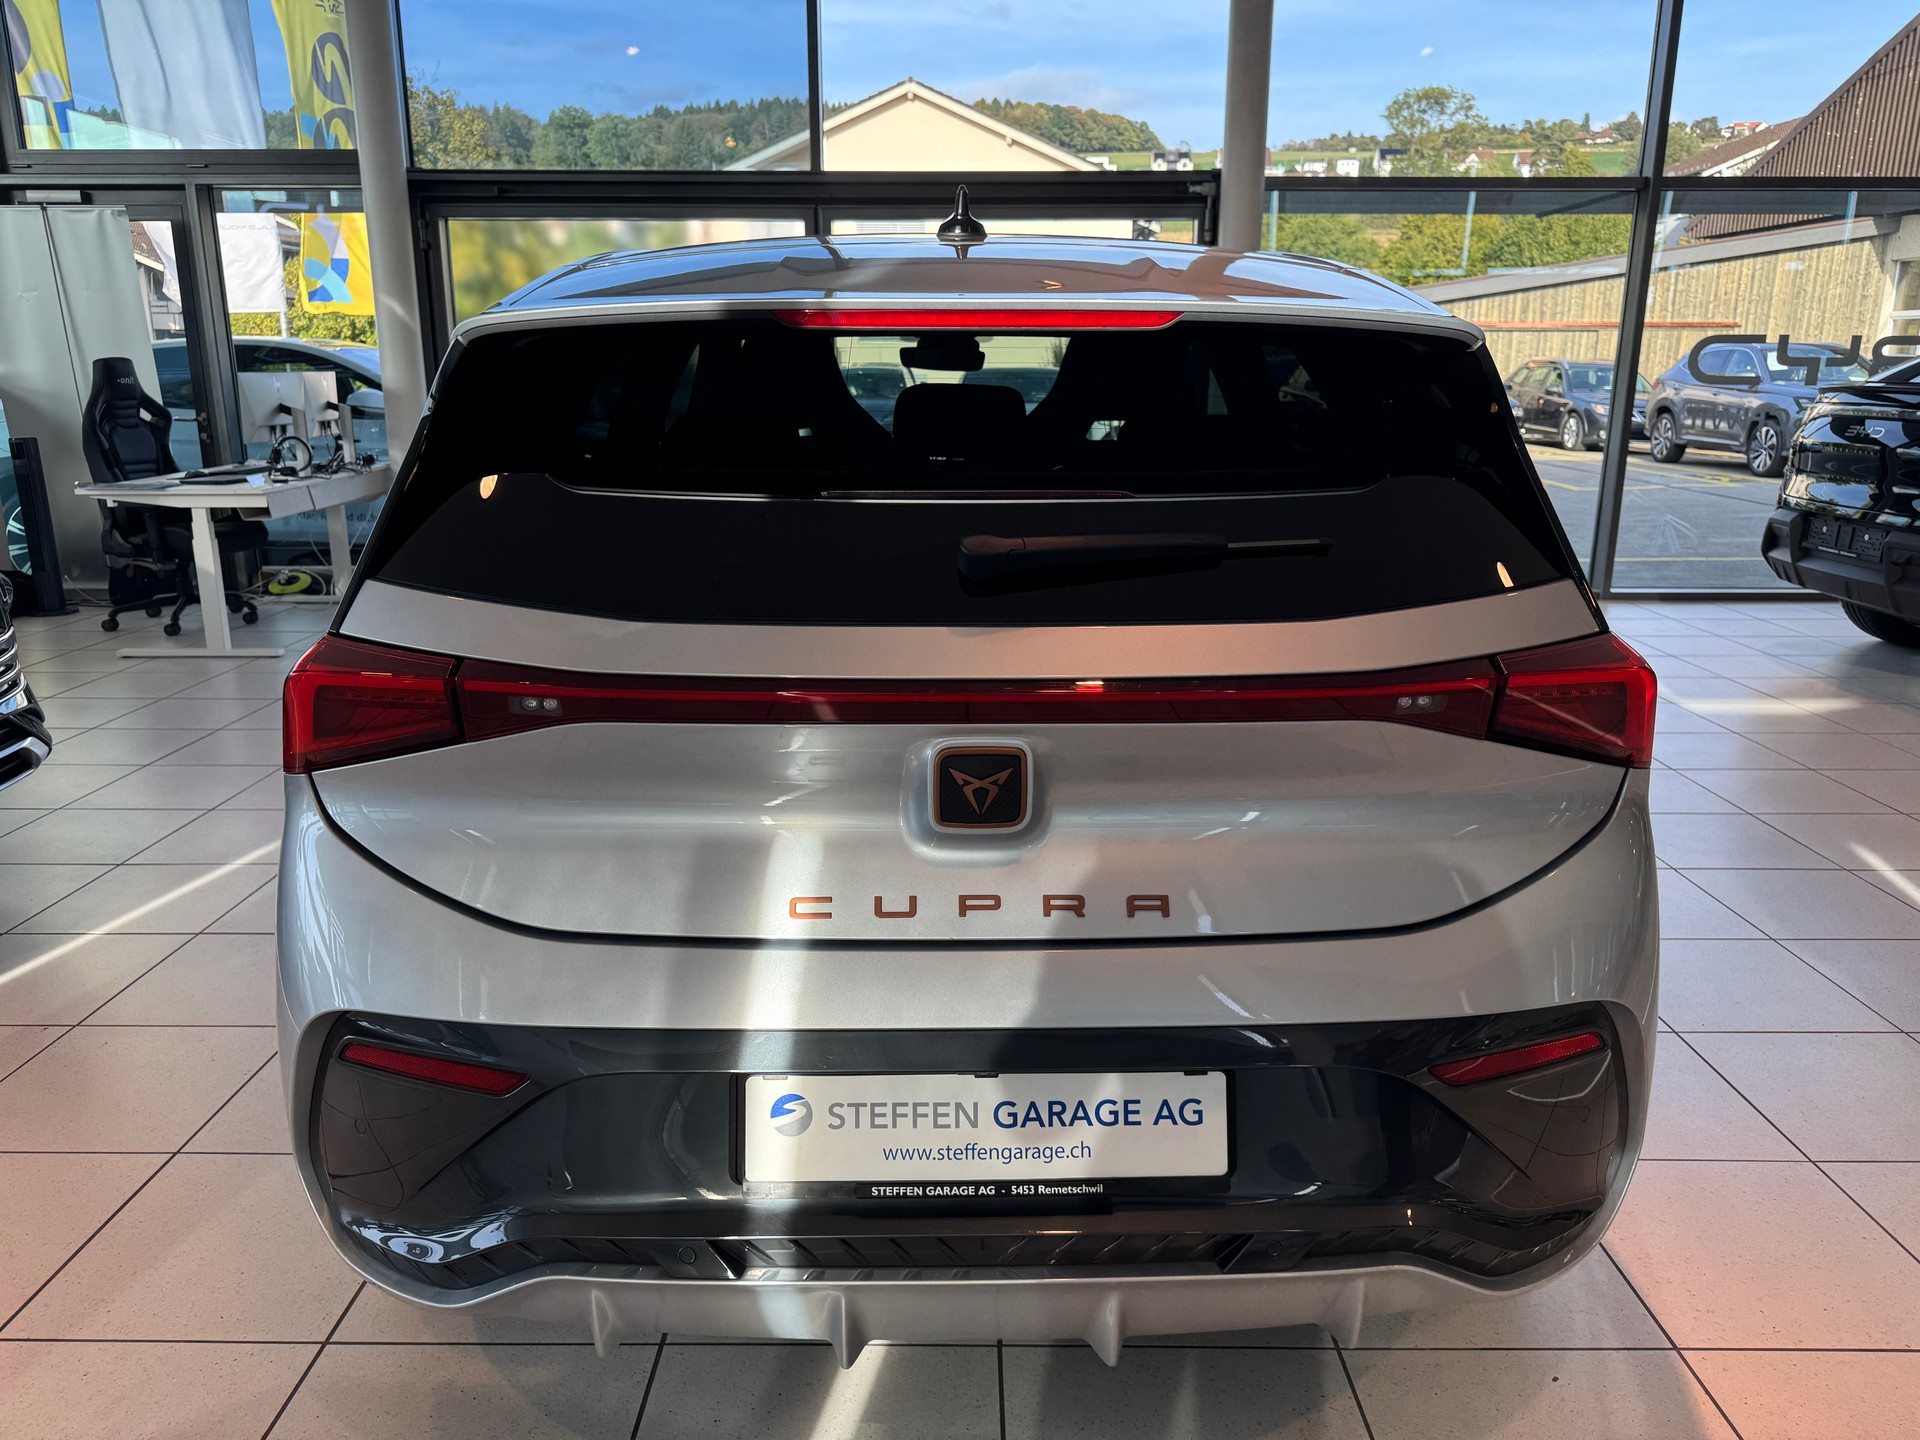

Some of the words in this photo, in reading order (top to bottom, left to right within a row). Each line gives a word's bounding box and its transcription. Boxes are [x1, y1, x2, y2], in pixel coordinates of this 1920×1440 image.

[788, 893, 1171, 920] CUPRA
[827, 1101, 979, 1130] STEFFEN
[993, 1098, 1142, 1129] GARAGE
[1152, 1098, 1204, 1127] AG
[883, 1141, 1092, 1165] www.steffengarage.ch
[871, 1186, 923, 1197] STEFFEN
[927, 1186, 975, 1196] GARAGE
[978, 1185, 996, 1196] AG
[1011, 1185, 1035, 1196] 5453
[1038, 1183, 1104, 1195] Remetschwil
